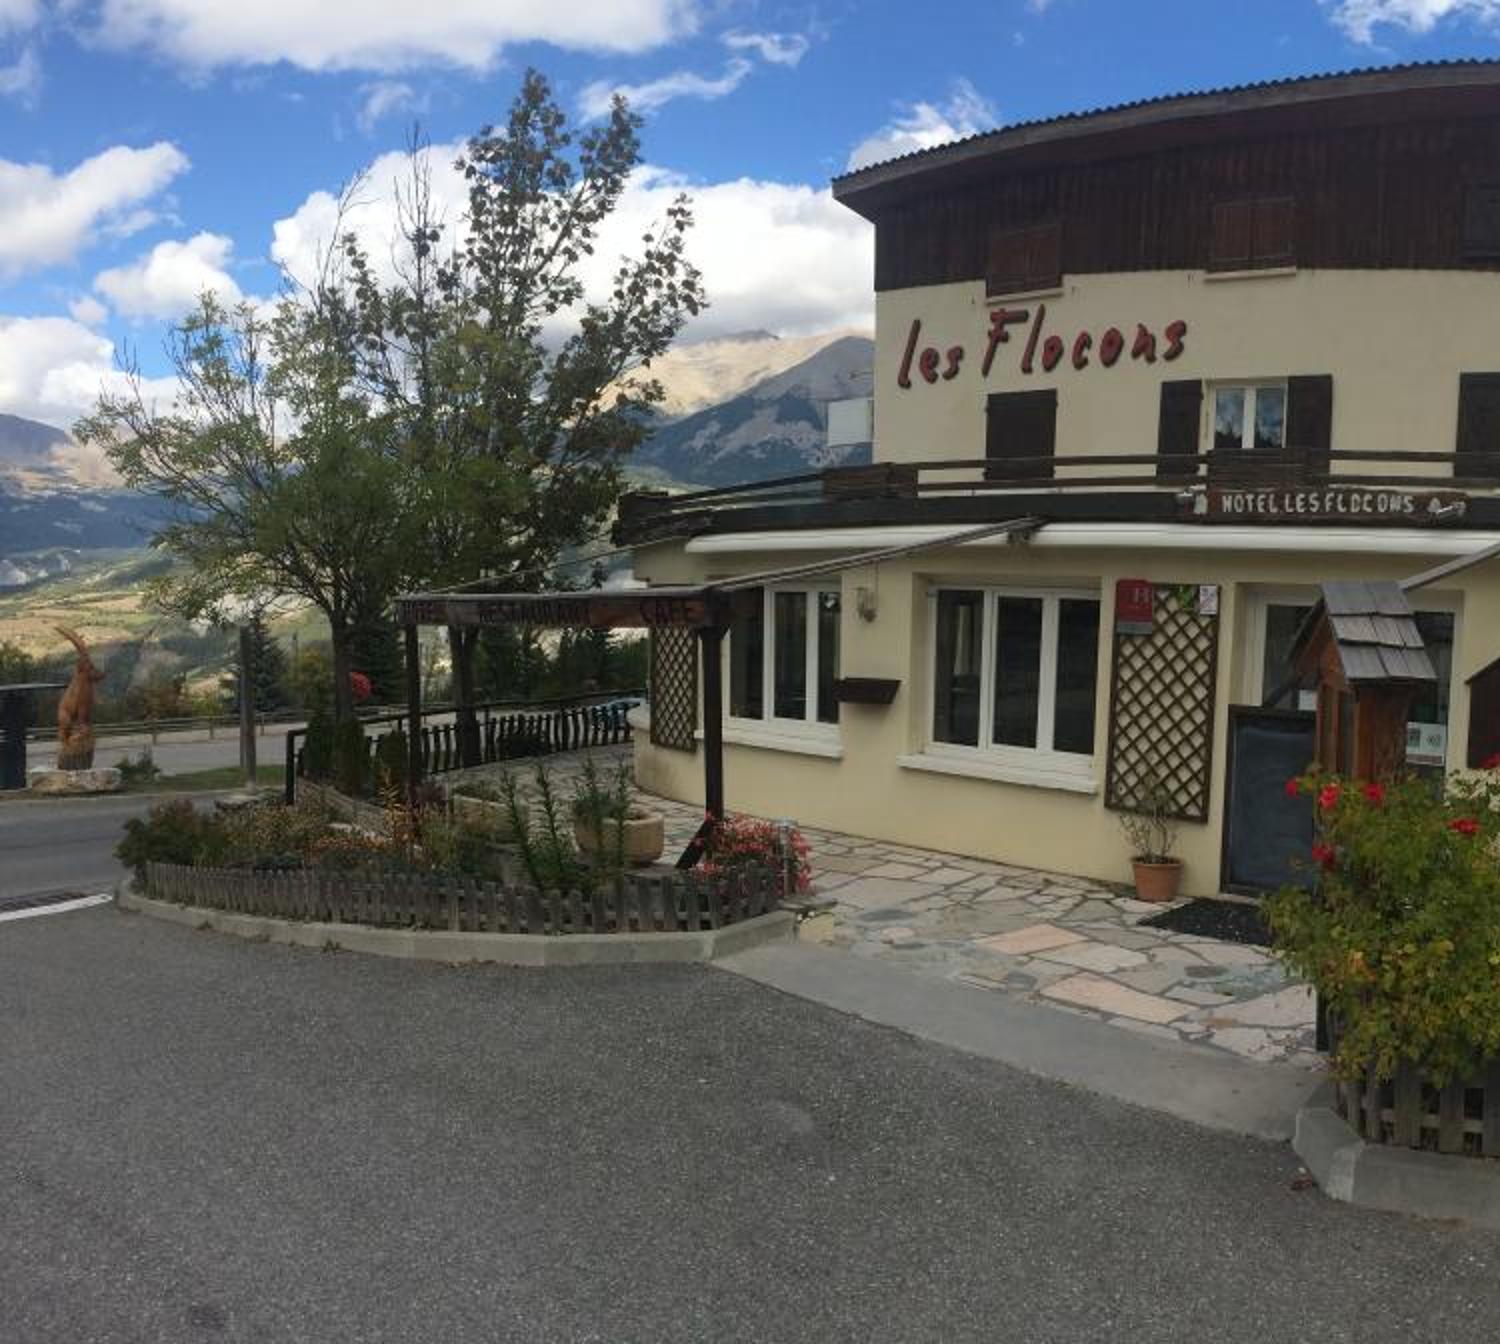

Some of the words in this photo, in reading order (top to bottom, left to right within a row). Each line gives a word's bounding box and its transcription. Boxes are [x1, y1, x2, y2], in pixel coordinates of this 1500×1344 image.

[897, 318, 965, 389] les
[980, 303, 1187, 379] Flocons
[1222, 493, 1279, 513] HOTEL
[1285, 493, 1320, 513] LES
[1325, 492, 1414, 513] FLOCONS
